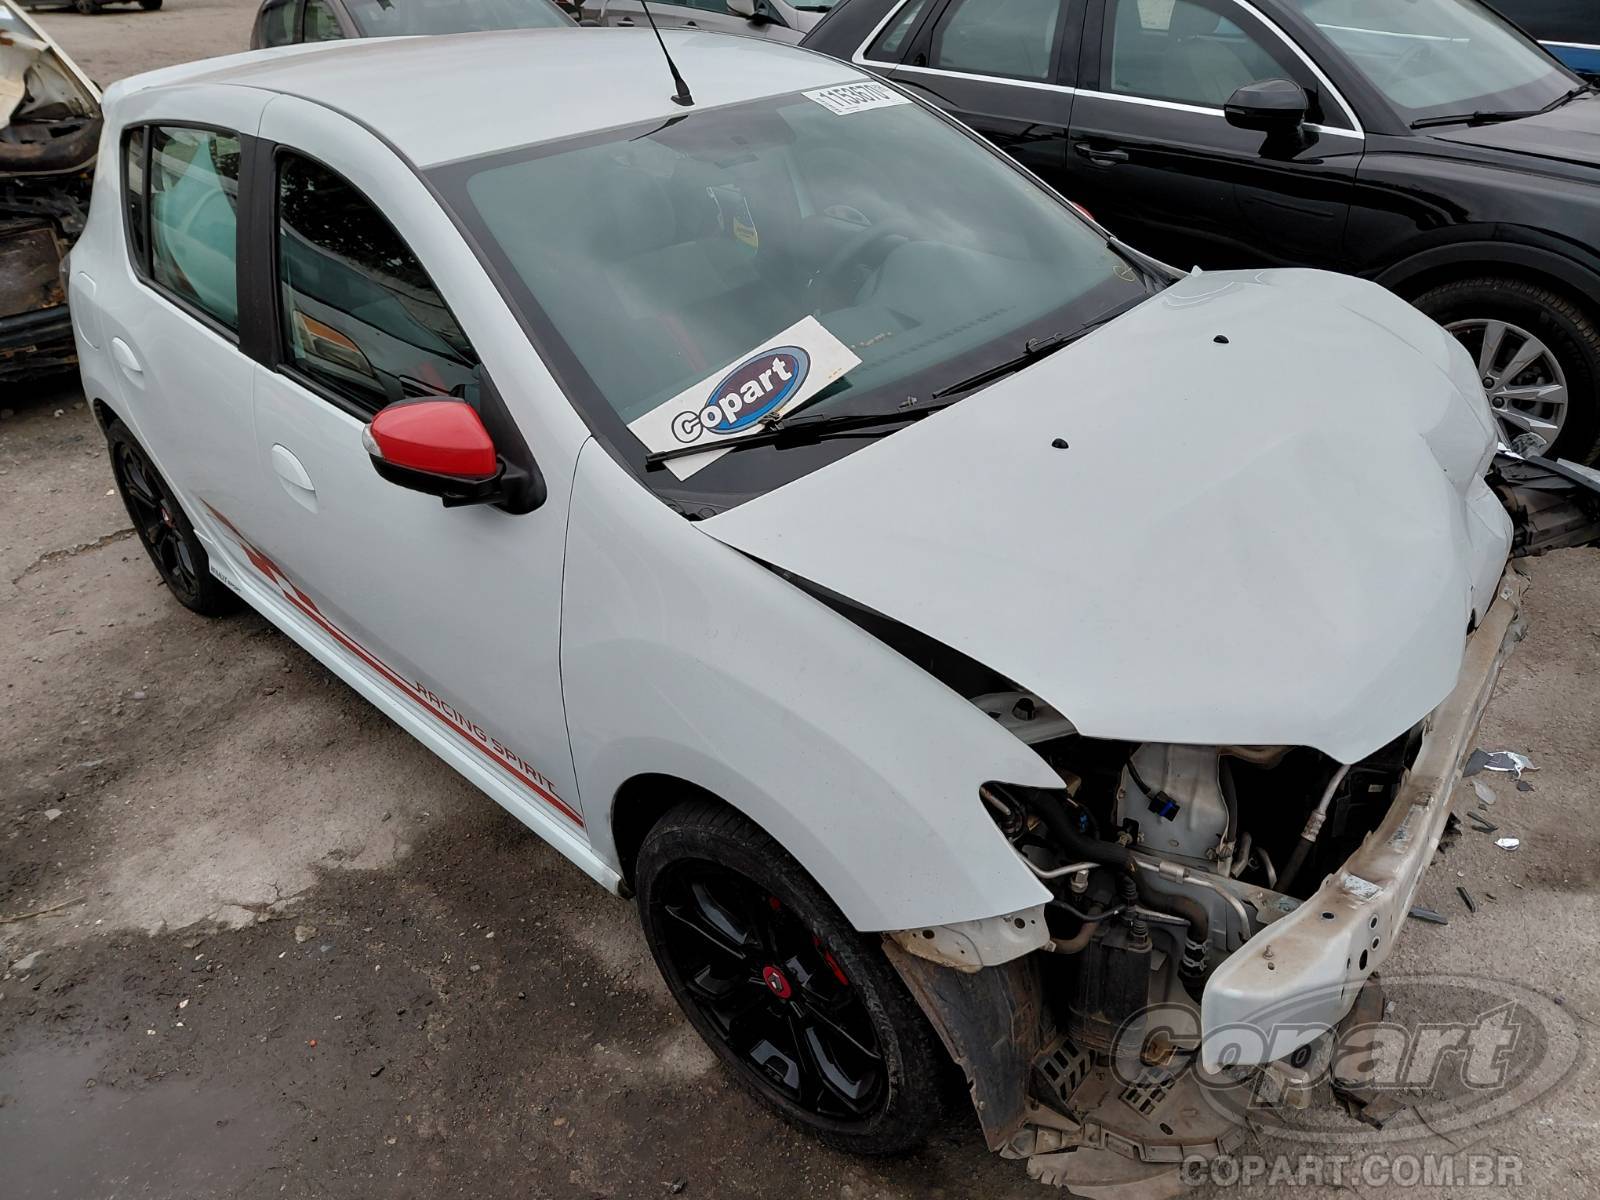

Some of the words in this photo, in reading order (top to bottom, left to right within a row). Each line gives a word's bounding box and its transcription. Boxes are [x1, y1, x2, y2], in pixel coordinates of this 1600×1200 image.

[672, 357, 793, 443] Copart
[415, 680, 487, 743] RACING
[491, 736, 557, 791] SPIRIT
